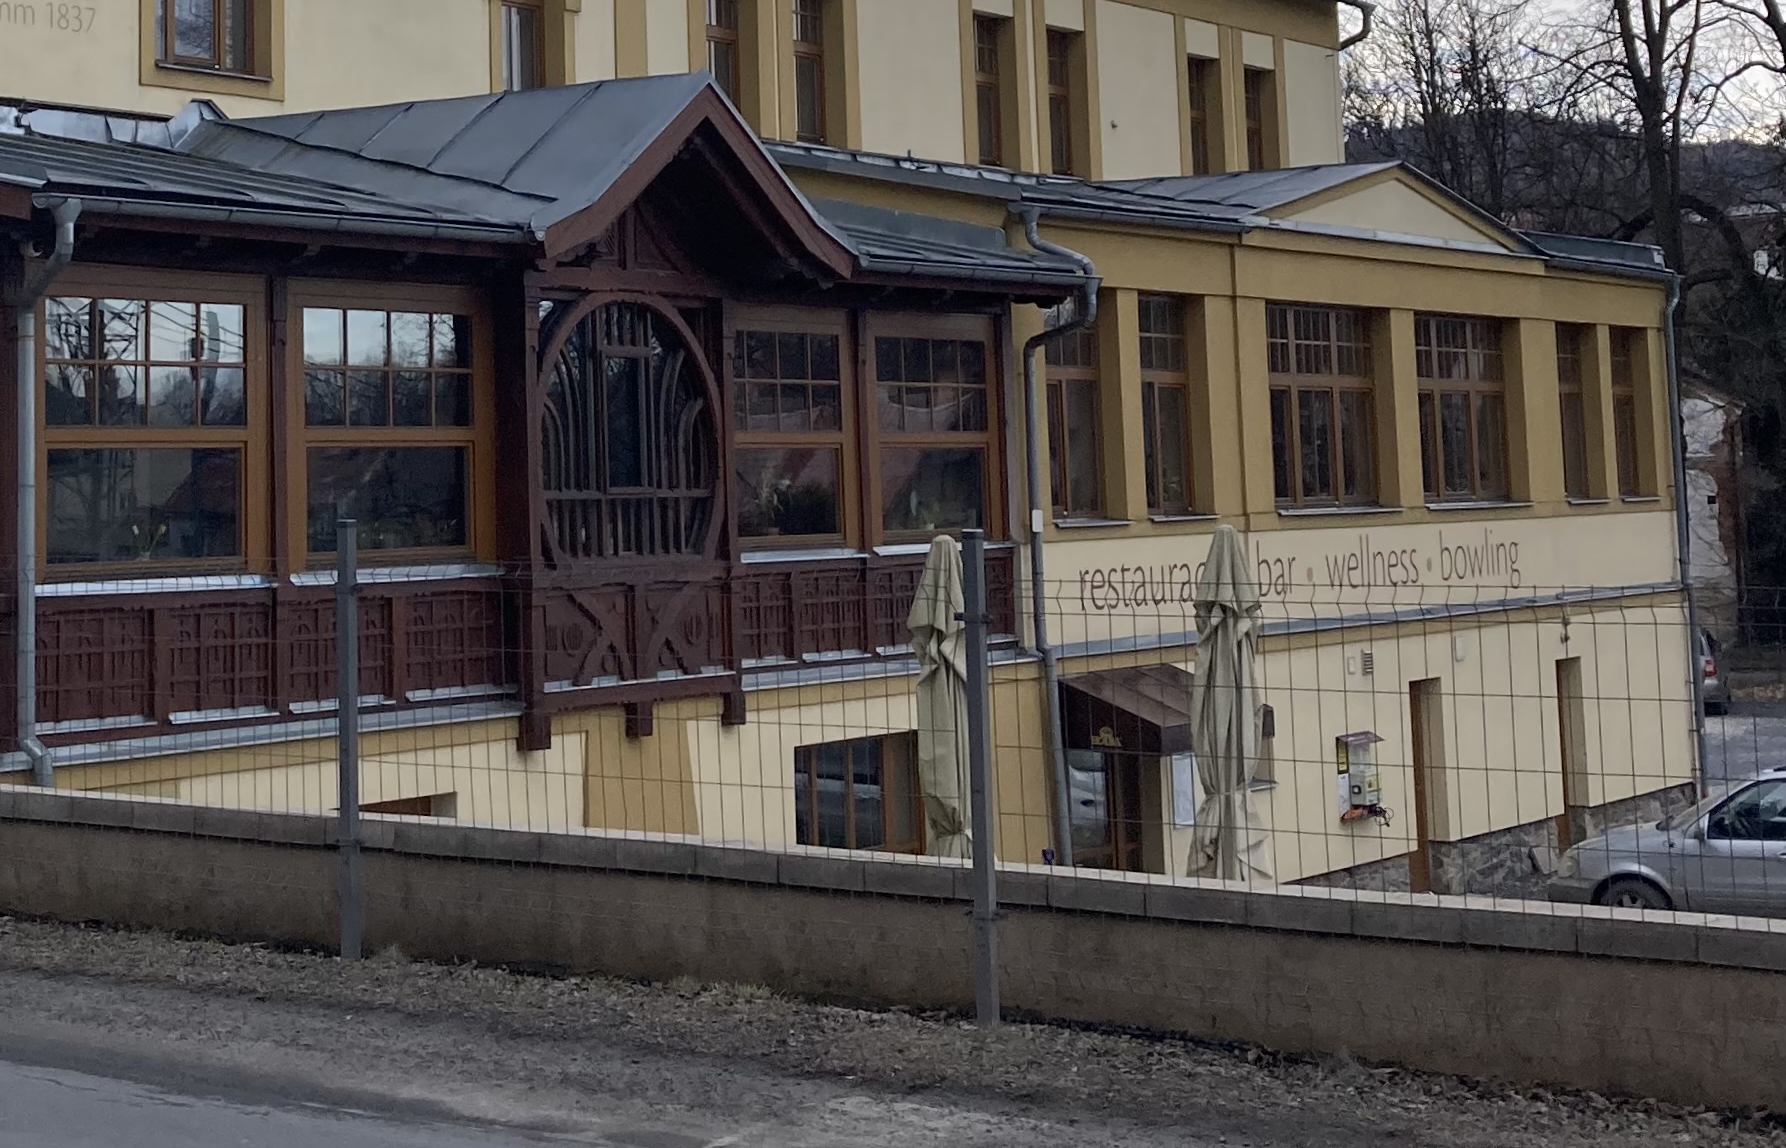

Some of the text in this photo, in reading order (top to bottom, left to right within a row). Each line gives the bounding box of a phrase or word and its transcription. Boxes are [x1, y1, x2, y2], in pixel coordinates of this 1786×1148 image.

[45, 2, 96, 33] 1837
[1256, 539, 1296, 598] bar
[1325, 533, 1419, 589] wellness
[1439, 527, 1521, 589] bowling
